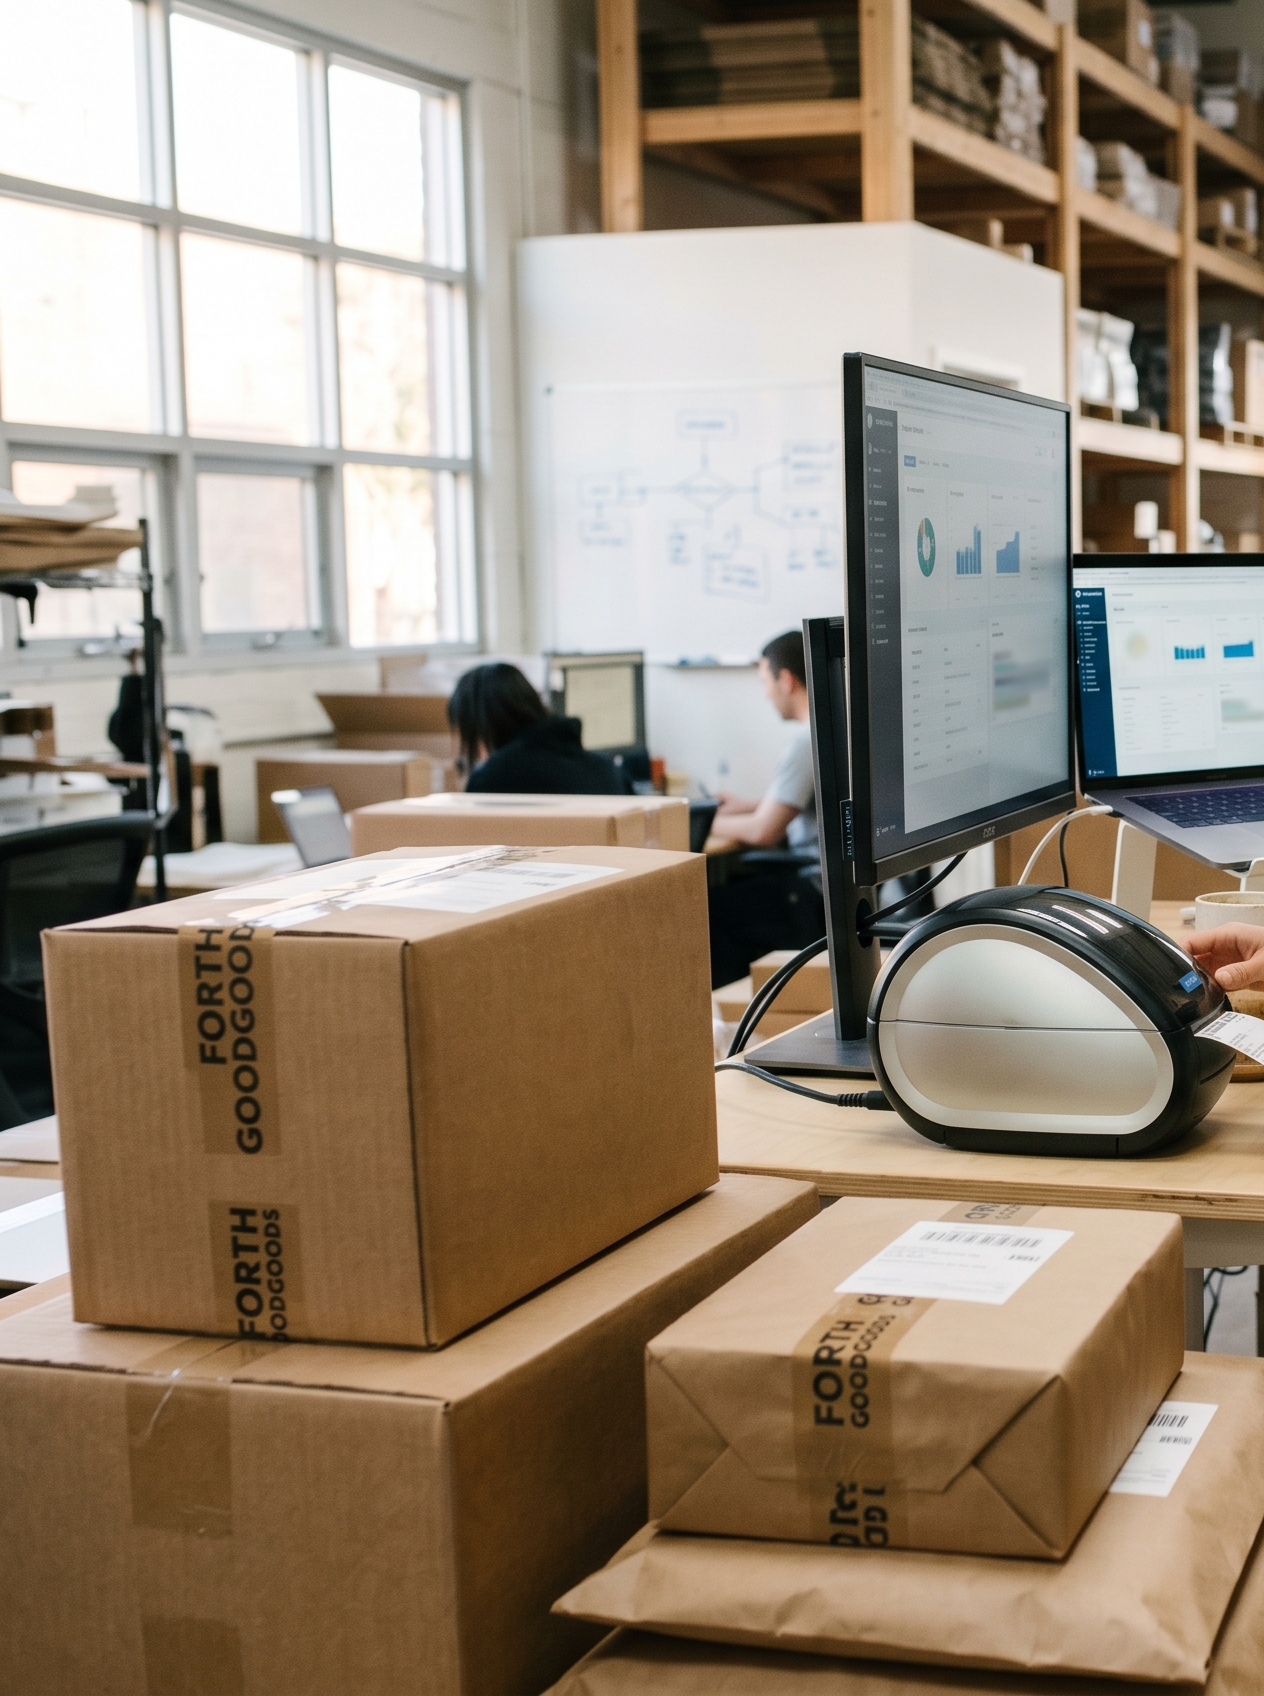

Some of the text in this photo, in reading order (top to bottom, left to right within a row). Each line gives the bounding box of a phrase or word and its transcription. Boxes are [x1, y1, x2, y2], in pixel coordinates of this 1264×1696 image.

[195, 929, 226, 1065] FORTH
[229, 1208, 268, 1340] FORTH
[813, 1319, 864, 1426] FORTH
